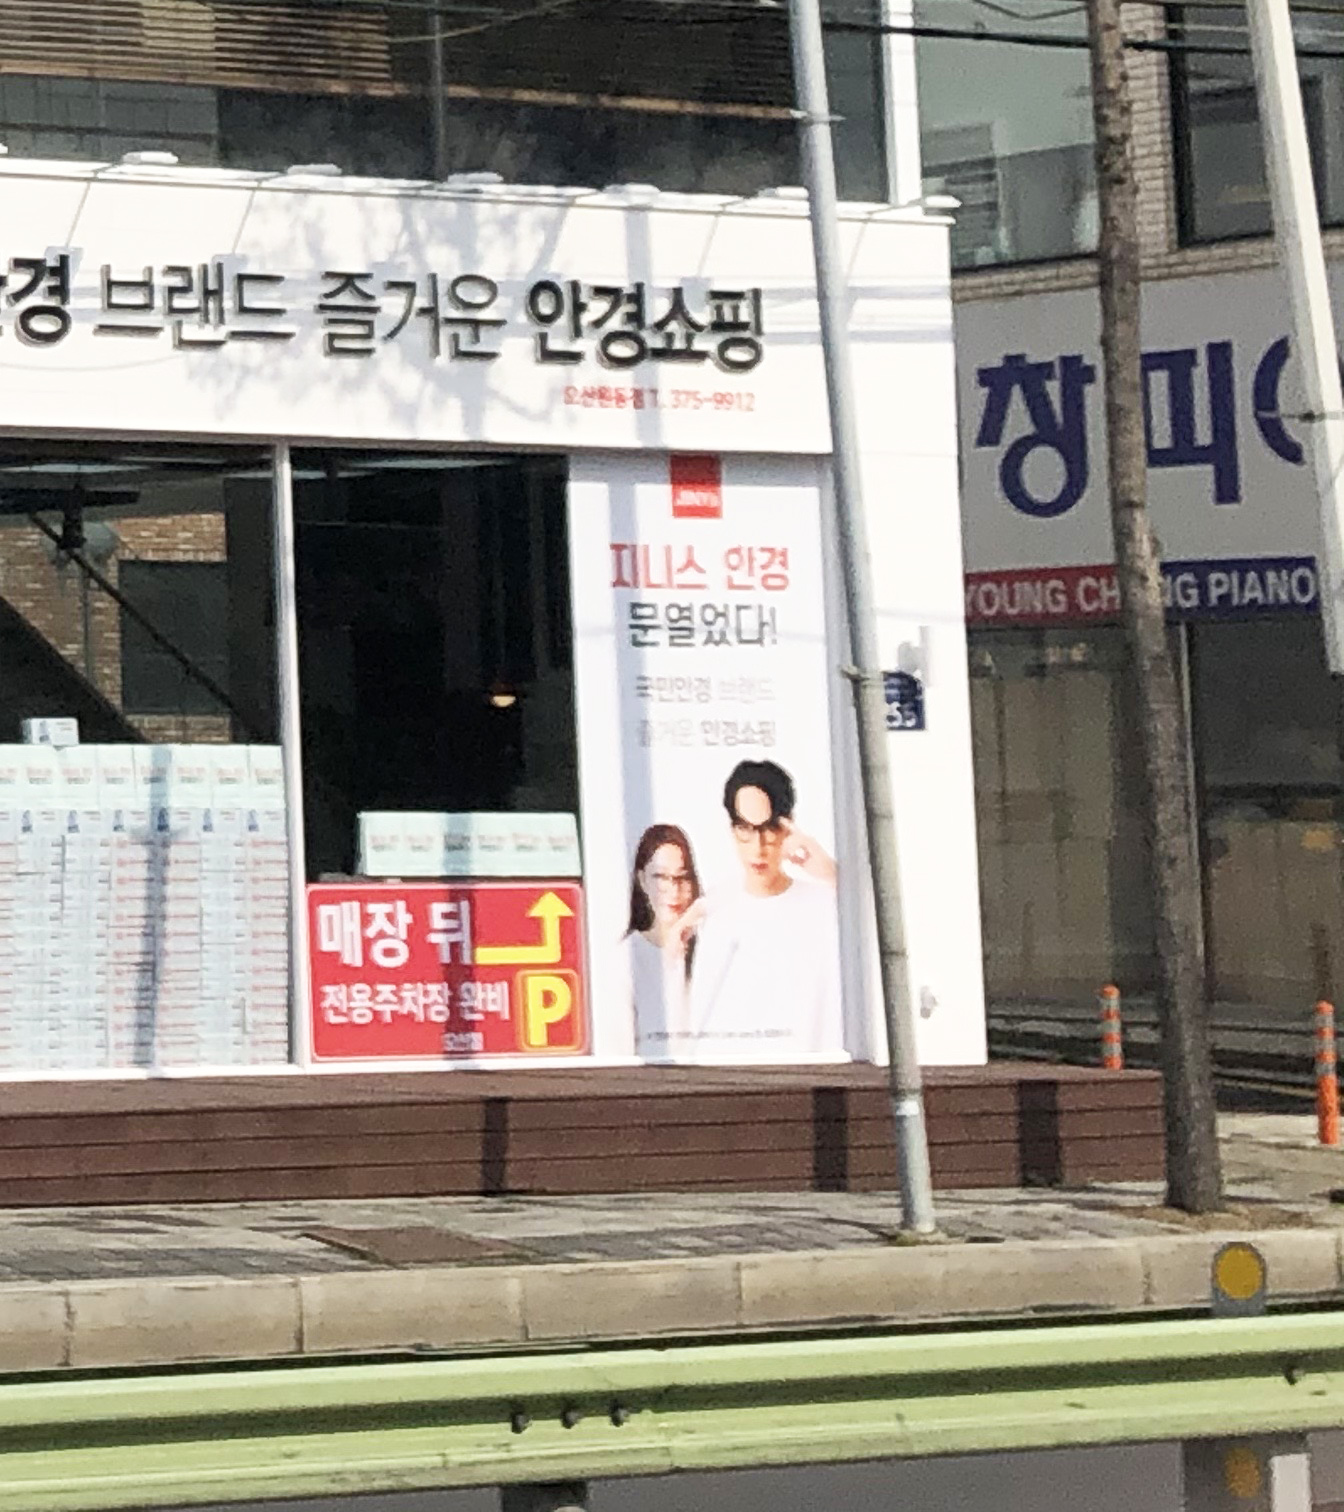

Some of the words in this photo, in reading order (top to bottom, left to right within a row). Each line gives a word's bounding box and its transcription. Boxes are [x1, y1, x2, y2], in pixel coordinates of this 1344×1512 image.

[94, 262, 295, 349] 브랜드
[317, 271, 508, 361] 즐거운
[526, 279, 765, 373] 안경쇼핑
[610, 543, 708, 588] 지니스
[723, 546, 790, 590] 안경
[1076, 572, 1199, 614] CHG
[1208, 566, 1313, 608] PIANO
[628, 601, 777, 647] 문열었다!
[316, 900, 413, 968] 매장
[427, 900, 472, 965] 뒤
[320, 980, 450, 1025] 전용주차장
[460, 980, 510, 1021] 완비
